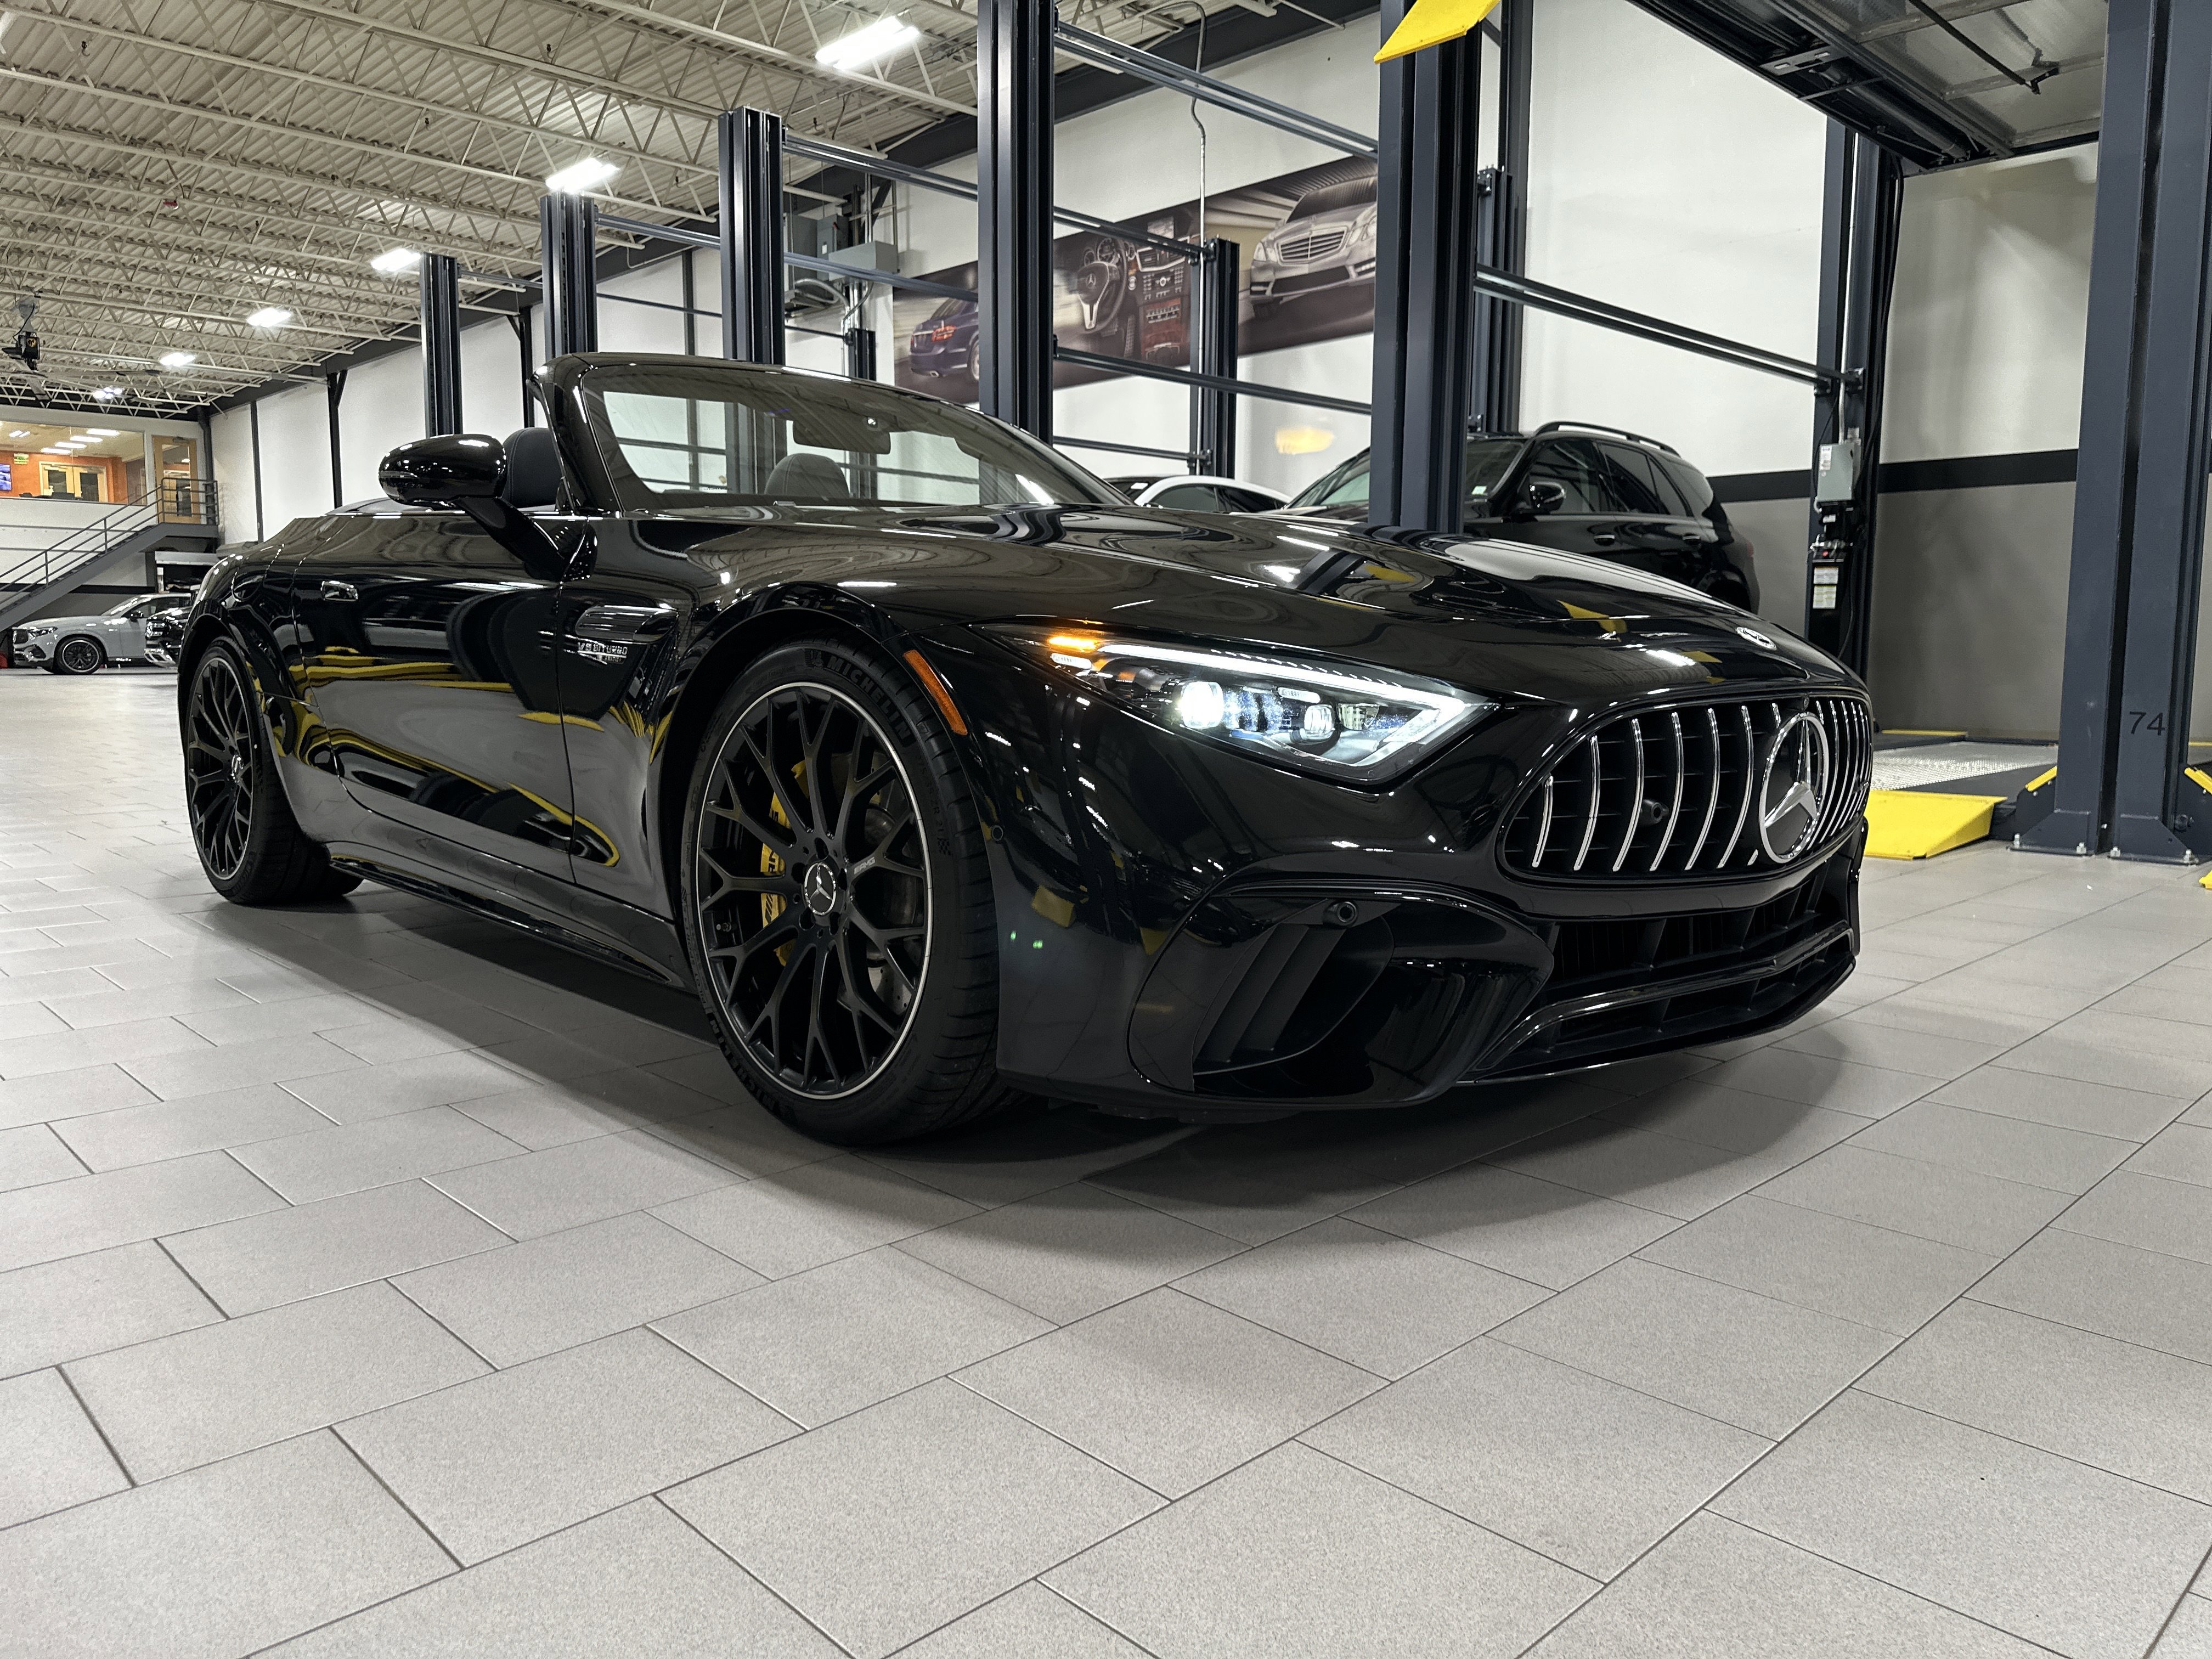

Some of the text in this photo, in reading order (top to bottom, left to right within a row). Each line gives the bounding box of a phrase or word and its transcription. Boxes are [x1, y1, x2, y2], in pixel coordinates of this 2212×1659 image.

[577, 642, 628, 655] V8 BITURBO
[827, 656, 911, 741] MICHELIN
[2129, 712, 2165, 736] 74
[859, 856, 876, 871] AMG
